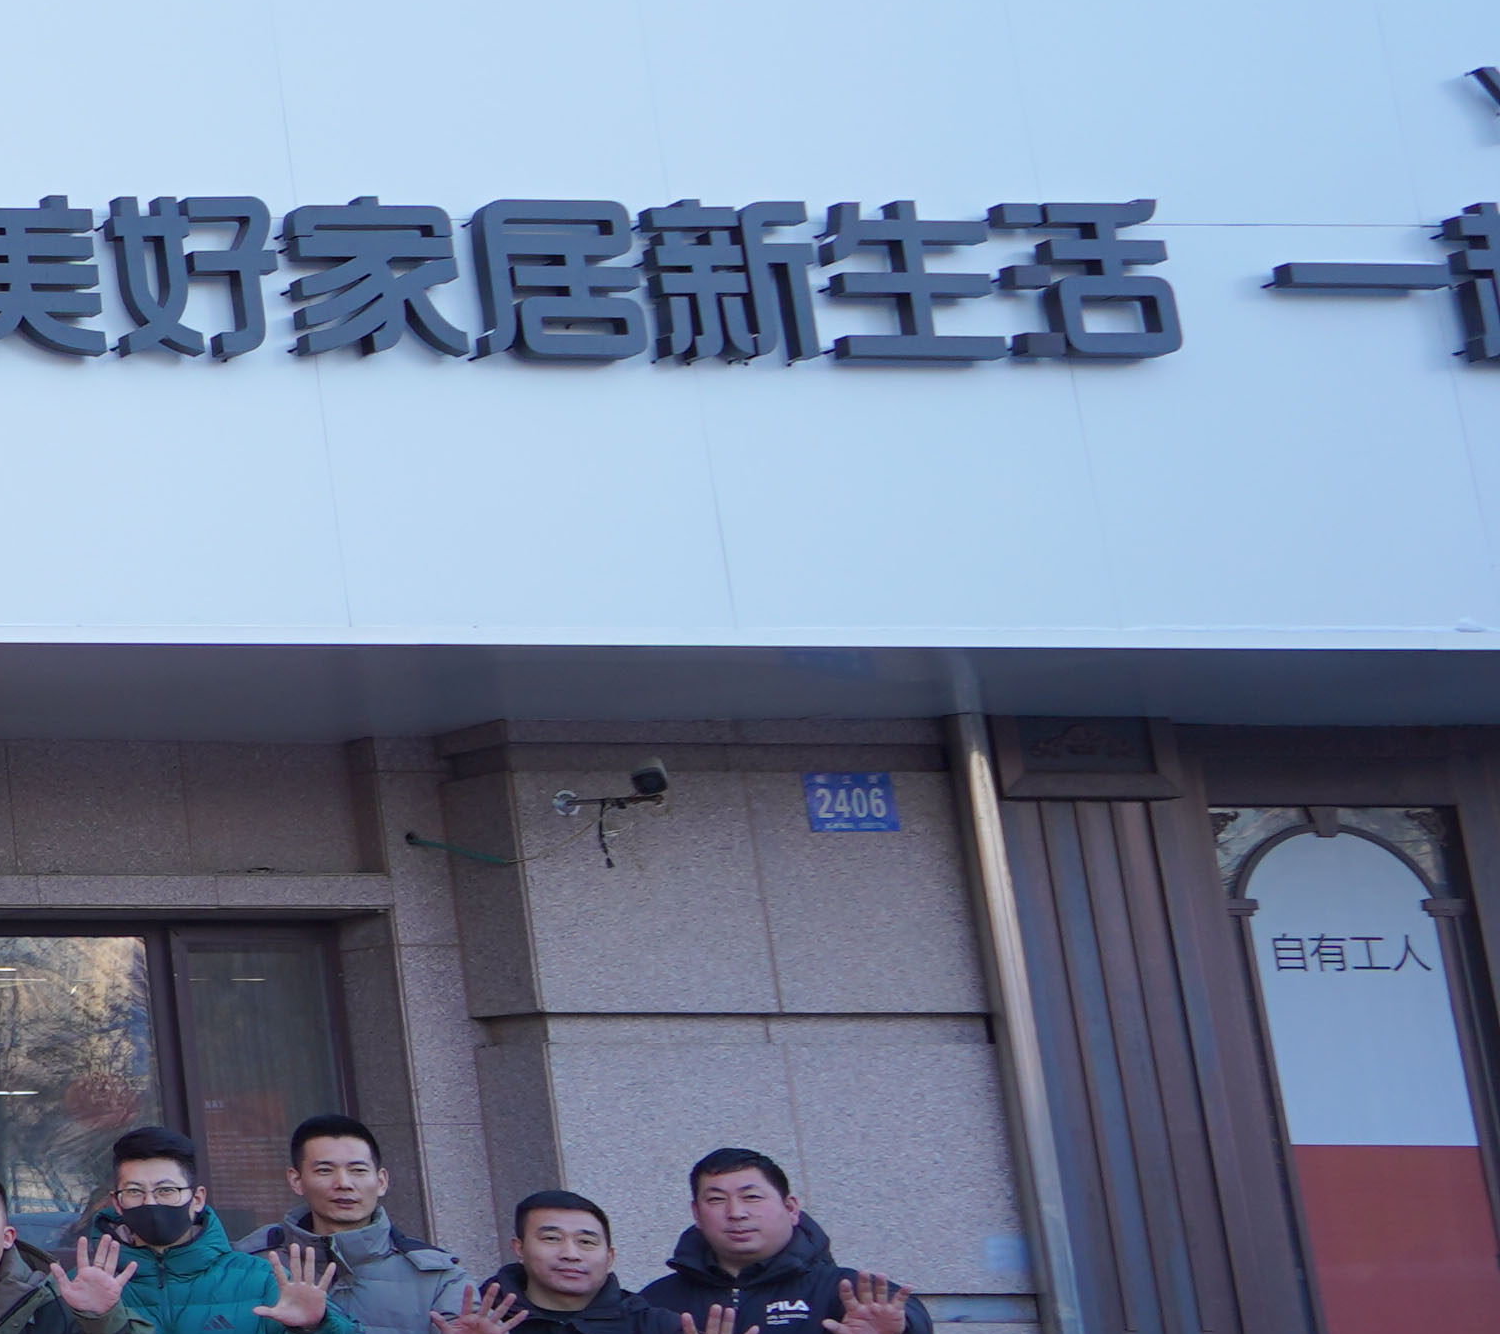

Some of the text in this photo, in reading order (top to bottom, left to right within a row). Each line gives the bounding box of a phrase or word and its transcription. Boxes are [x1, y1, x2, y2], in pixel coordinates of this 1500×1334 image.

[815, 787, 887, 819] 2406
[1271, 933, 1432, 972] 自有工人
[766, 1299, 811, 1313] FILA
